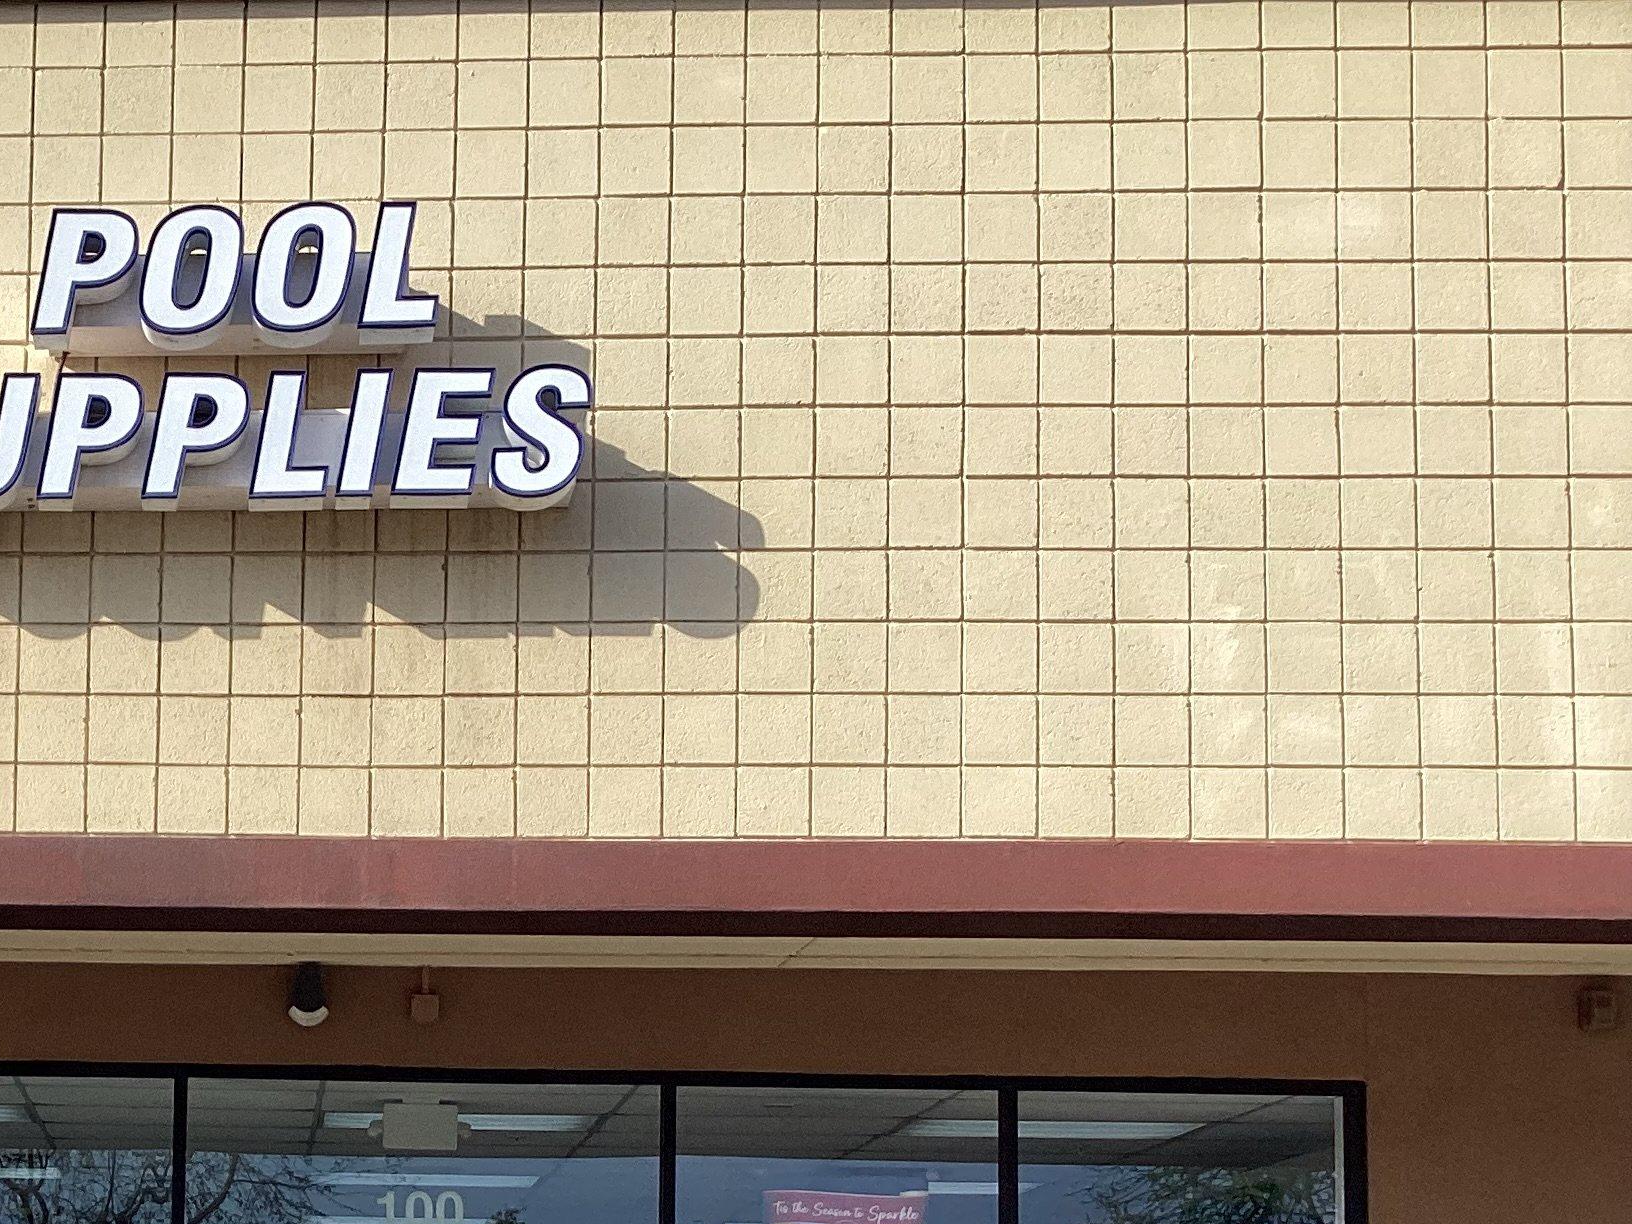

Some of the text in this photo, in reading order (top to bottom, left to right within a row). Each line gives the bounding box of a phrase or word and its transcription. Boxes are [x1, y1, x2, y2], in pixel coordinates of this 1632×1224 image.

[30, 201, 440, 337] POOL
[791, 1201, 809, 1213] the
[811, 1201, 853, 1217] Season
[866, 1205, 920, 1224] Sparkle
